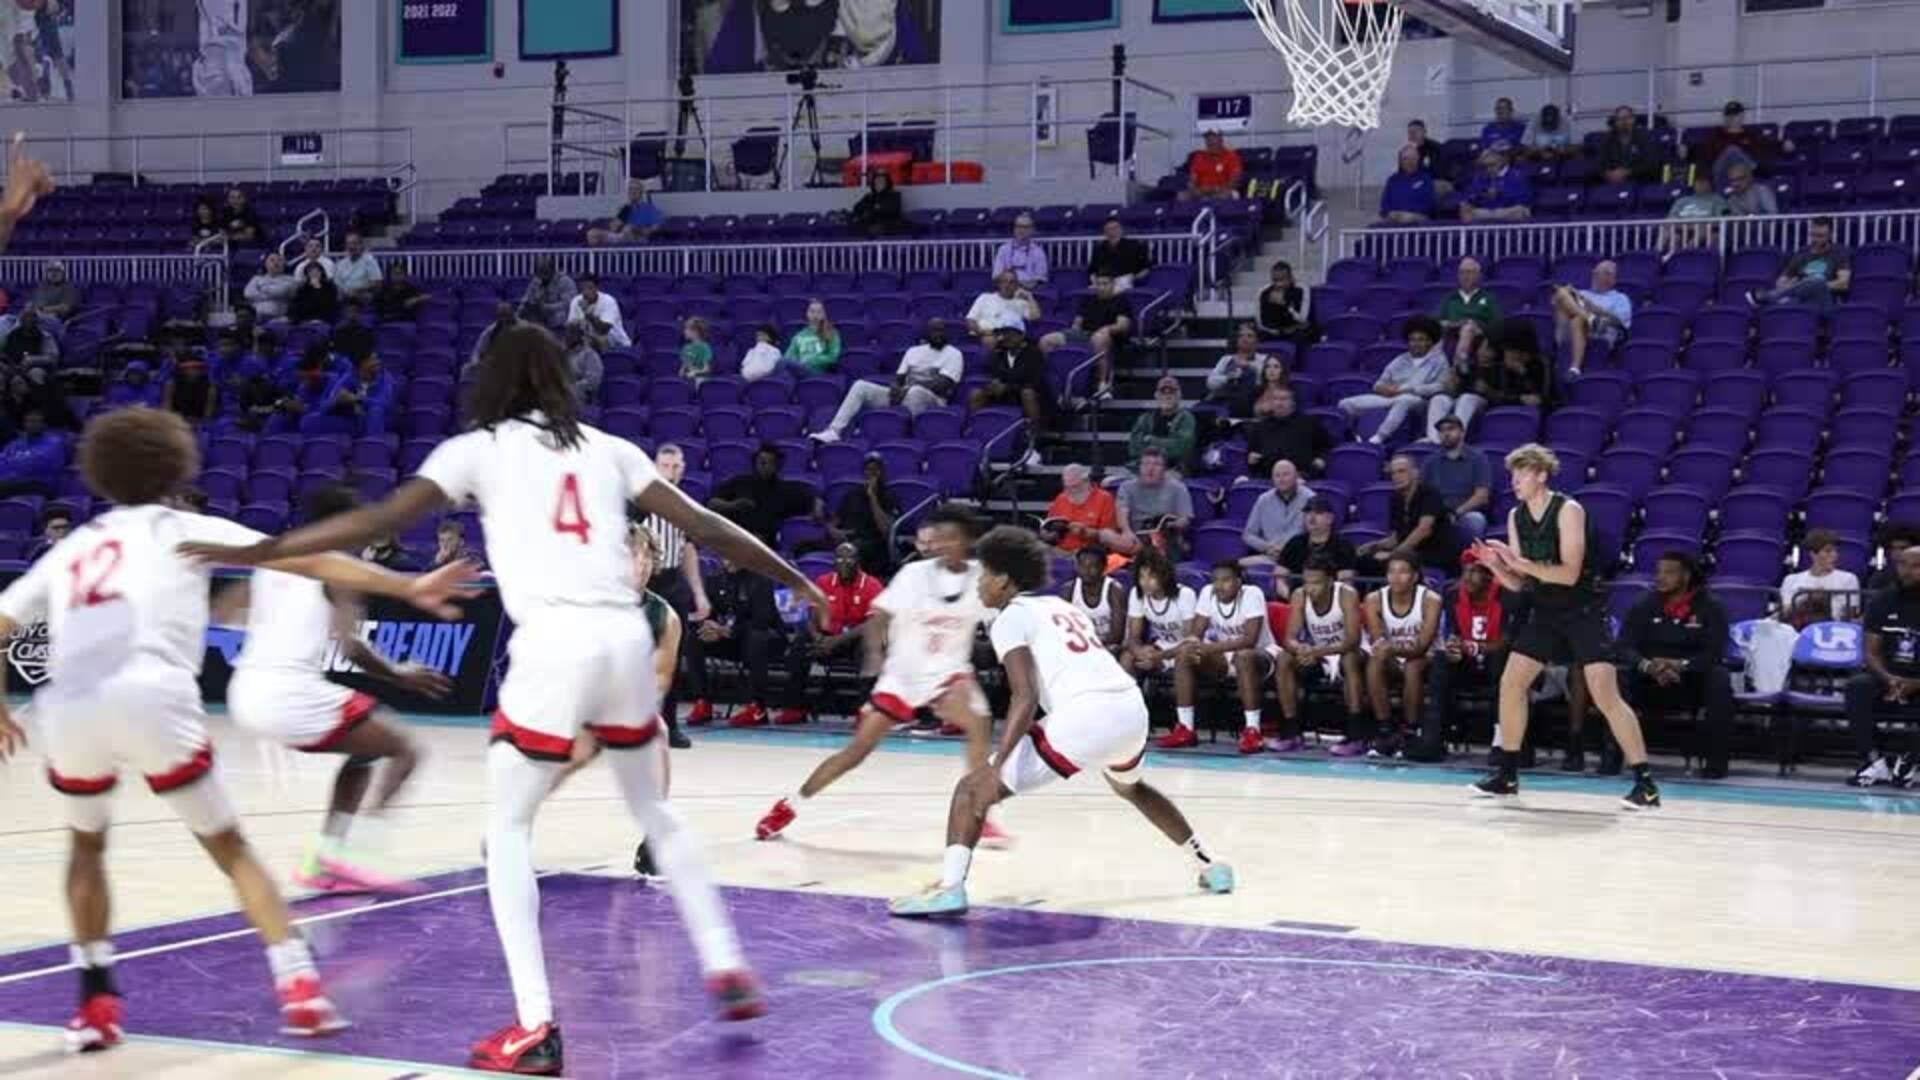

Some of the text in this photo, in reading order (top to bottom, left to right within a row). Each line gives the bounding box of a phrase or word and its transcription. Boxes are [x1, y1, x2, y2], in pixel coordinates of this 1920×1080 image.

[1217, 100, 1241, 114] 117
[554, 473, 591, 544] 4
[69, 540, 125, 608] 12
